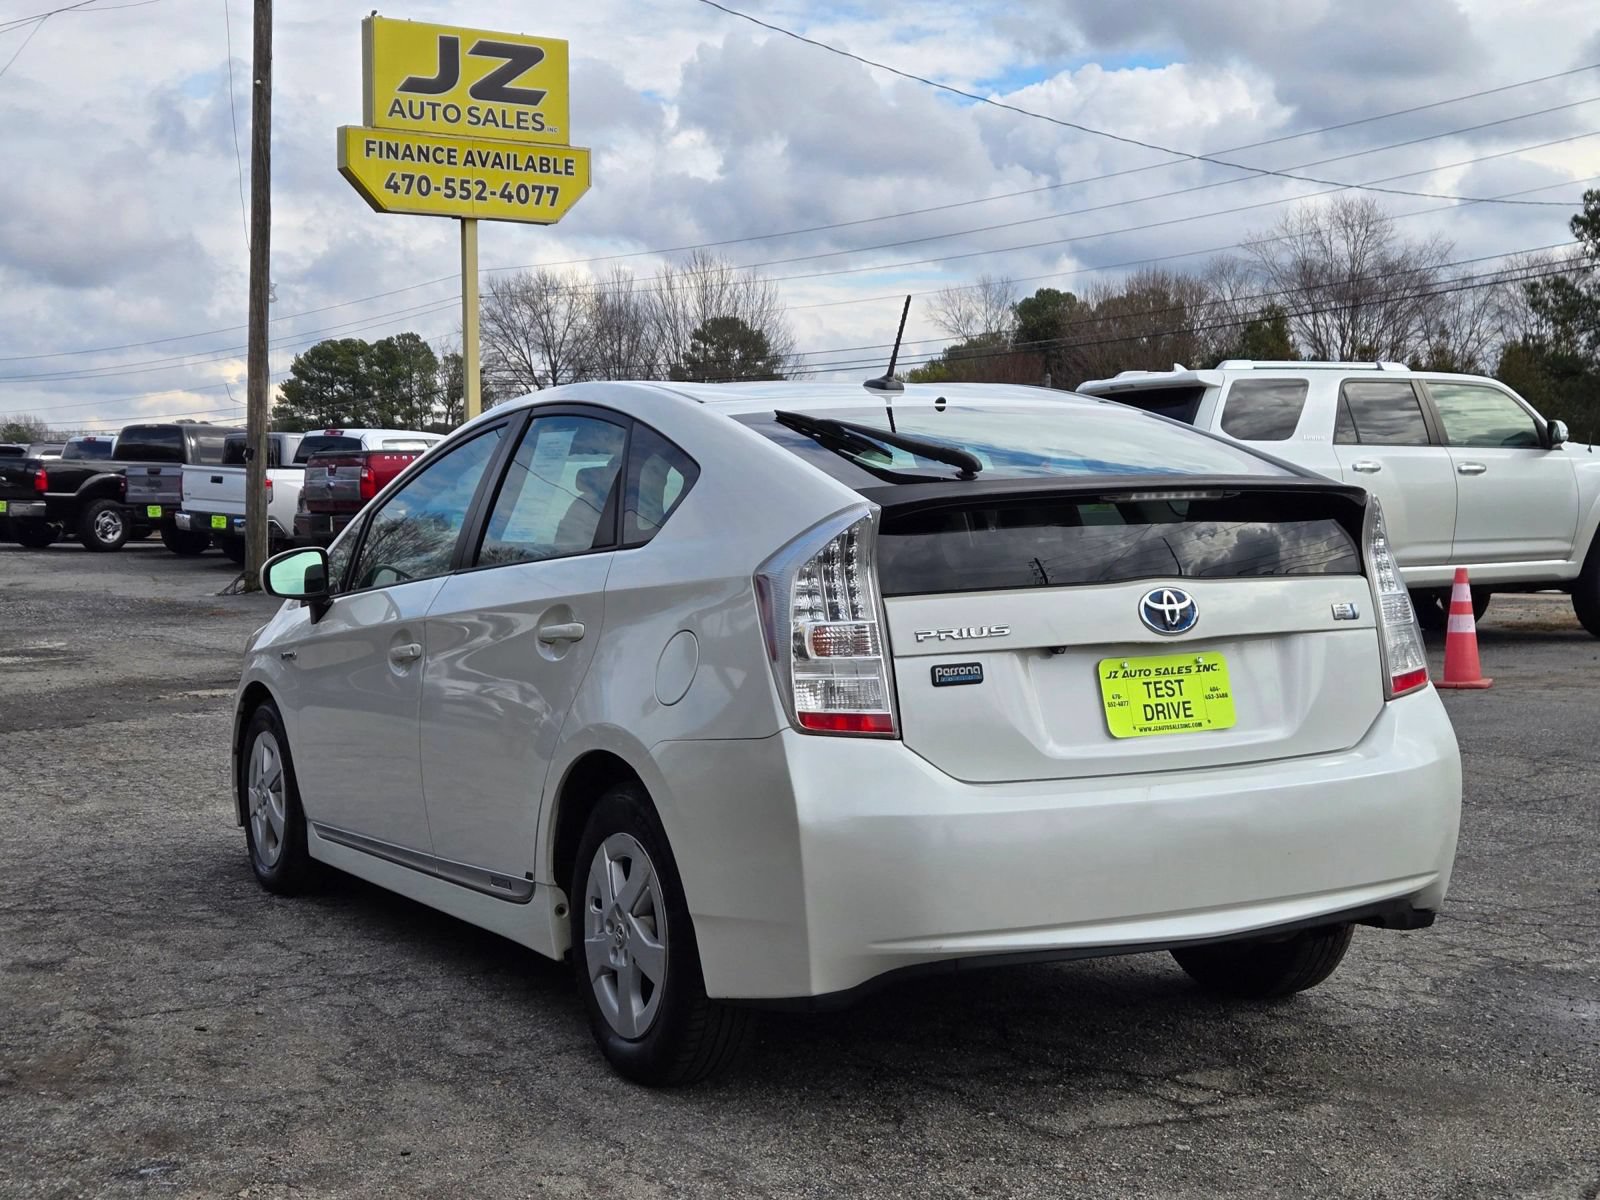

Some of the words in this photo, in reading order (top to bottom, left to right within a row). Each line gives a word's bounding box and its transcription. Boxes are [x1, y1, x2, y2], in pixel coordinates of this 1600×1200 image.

[397, 35, 547, 106] JZ
[388, 98, 461, 124] AUTO
[467, 105, 545, 132] SALES
[365, 139, 457, 166] FINANCE
[463, 150, 575, 176] AVAILABLE
[384, 172, 559, 207] 470-552-4077
[914, 623, 1011, 643] PRIUS
[1105, 670, 1119, 680] JZ
[1121, 668, 1152, 679] AUTO
[1154, 665, 1192, 676] SALES
[1195, 663, 1220, 673] INC.
[1142, 679, 1185, 699] TEST
[1143, 700, 1194, 722] DRIVE
